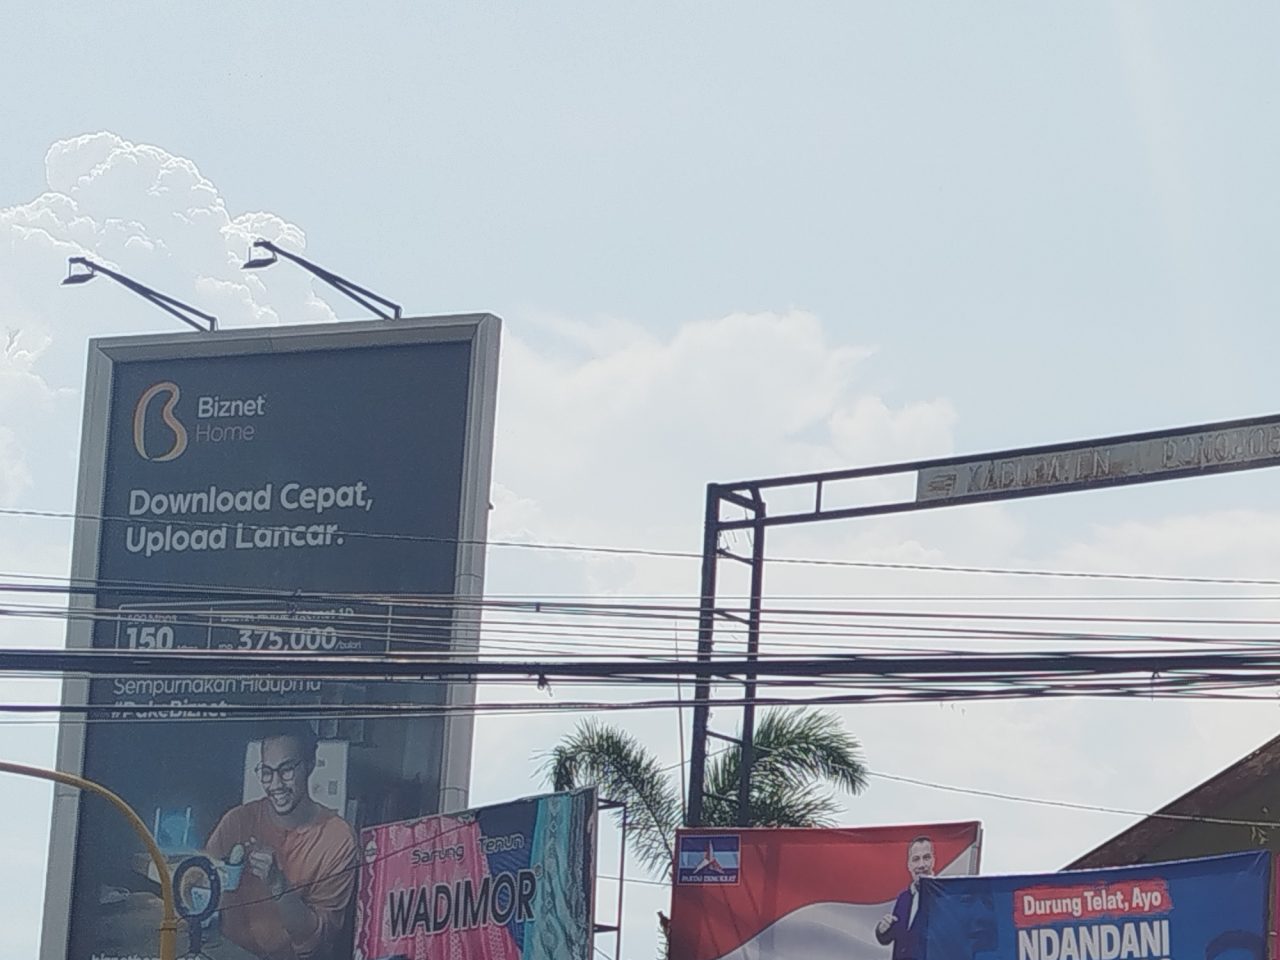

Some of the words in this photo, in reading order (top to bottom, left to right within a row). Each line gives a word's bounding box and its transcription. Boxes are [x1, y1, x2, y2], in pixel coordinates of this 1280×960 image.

[197, 395, 265, 418] Biznet
[195, 424, 255, 443] Home
[129, 484, 272, 516] Download
[280, 480, 373, 513] Cepat,
[126, 523, 227, 556] Upload
[236, 521, 344, 550] Lancar.
[126, 626, 174, 651] 150
[239, 626, 337, 651] 375,000
[113, 677, 235, 697] Sempurnakan
[411, 844, 465, 866] Sarung
[479, 833, 525, 854] Tenun
[388, 870, 538, 940] WADIMOR
[1023, 893, 1081, 917] Durung
[1083, 889, 1131, 912] Telat,
[1132, 886, 1162, 909] Ayo
